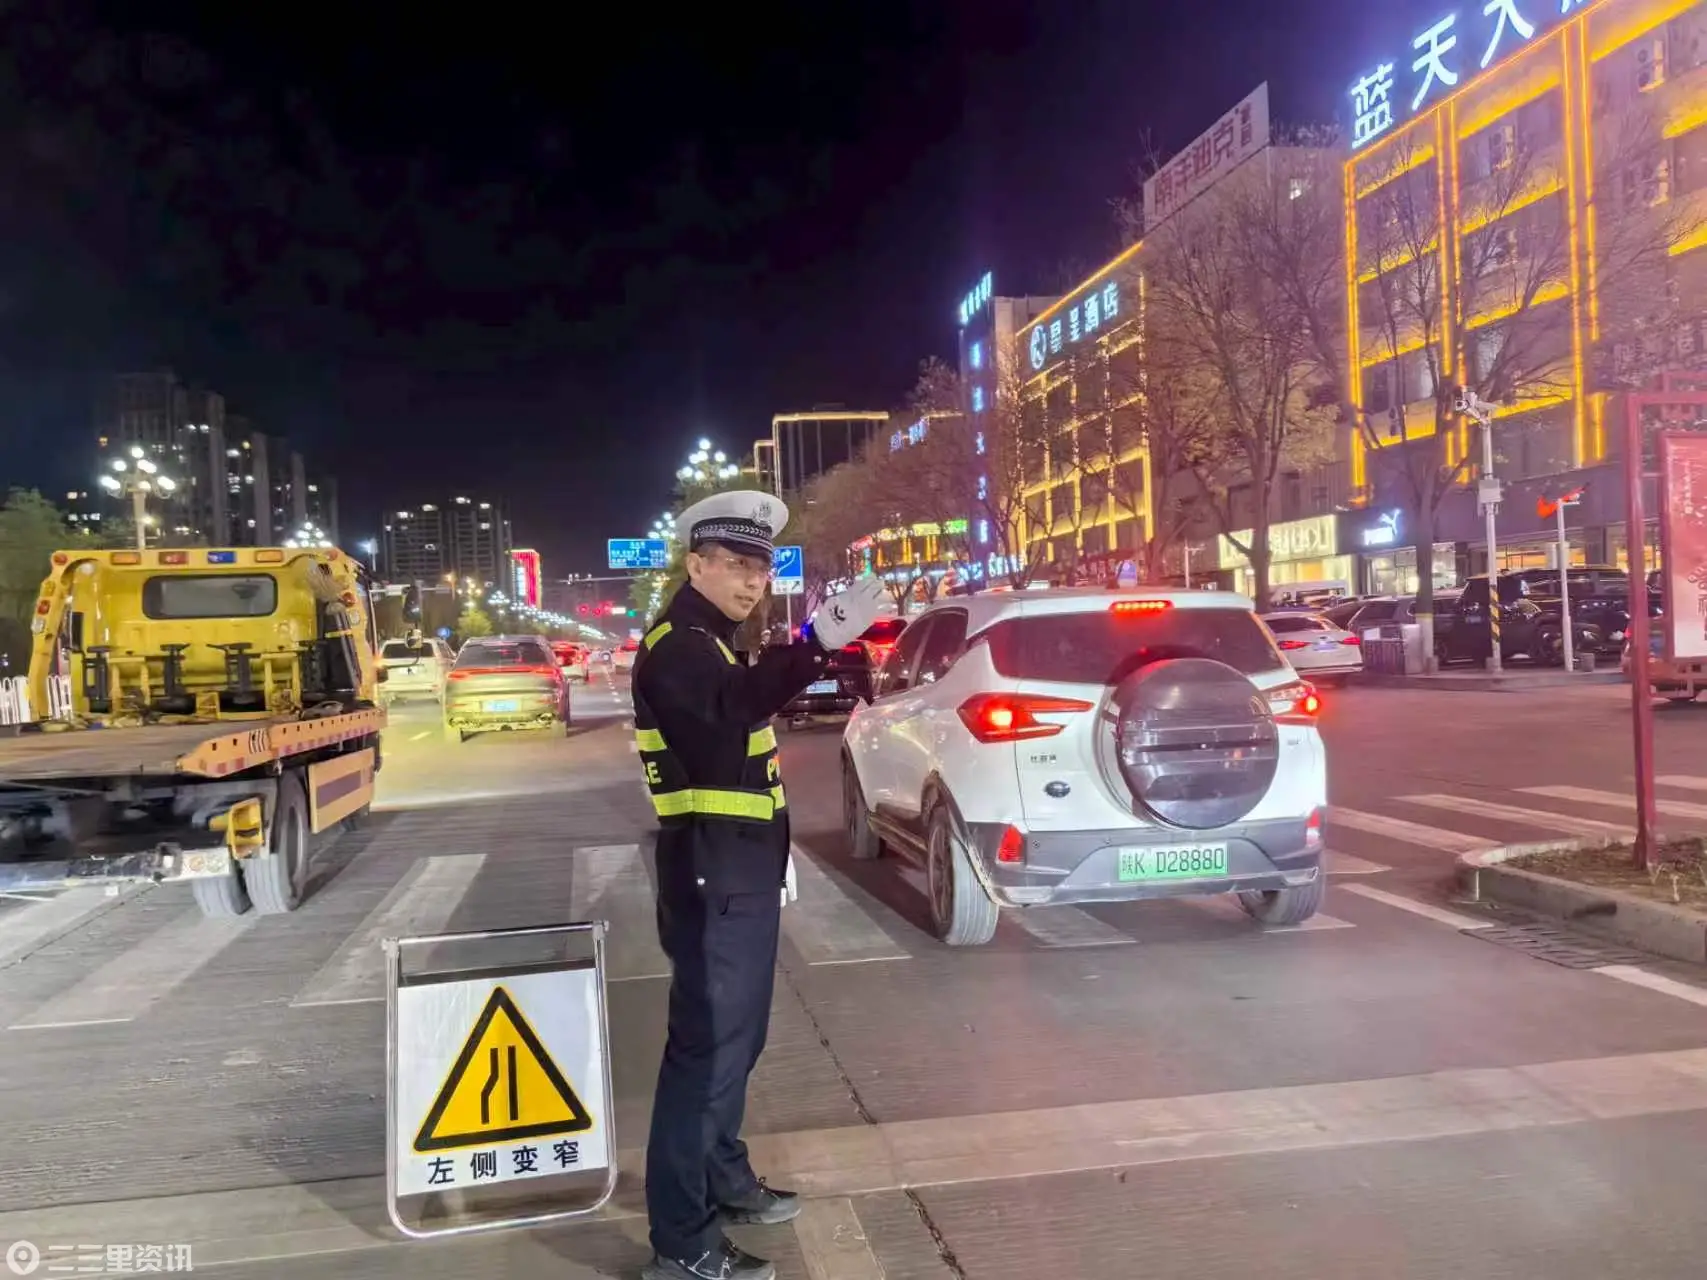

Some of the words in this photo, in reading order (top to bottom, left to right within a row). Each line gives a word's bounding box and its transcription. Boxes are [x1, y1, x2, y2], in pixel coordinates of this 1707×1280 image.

[1350, 0, 1585, 149] 蓝天大
[427, 1139, 580, 1185] 左侧变窄
